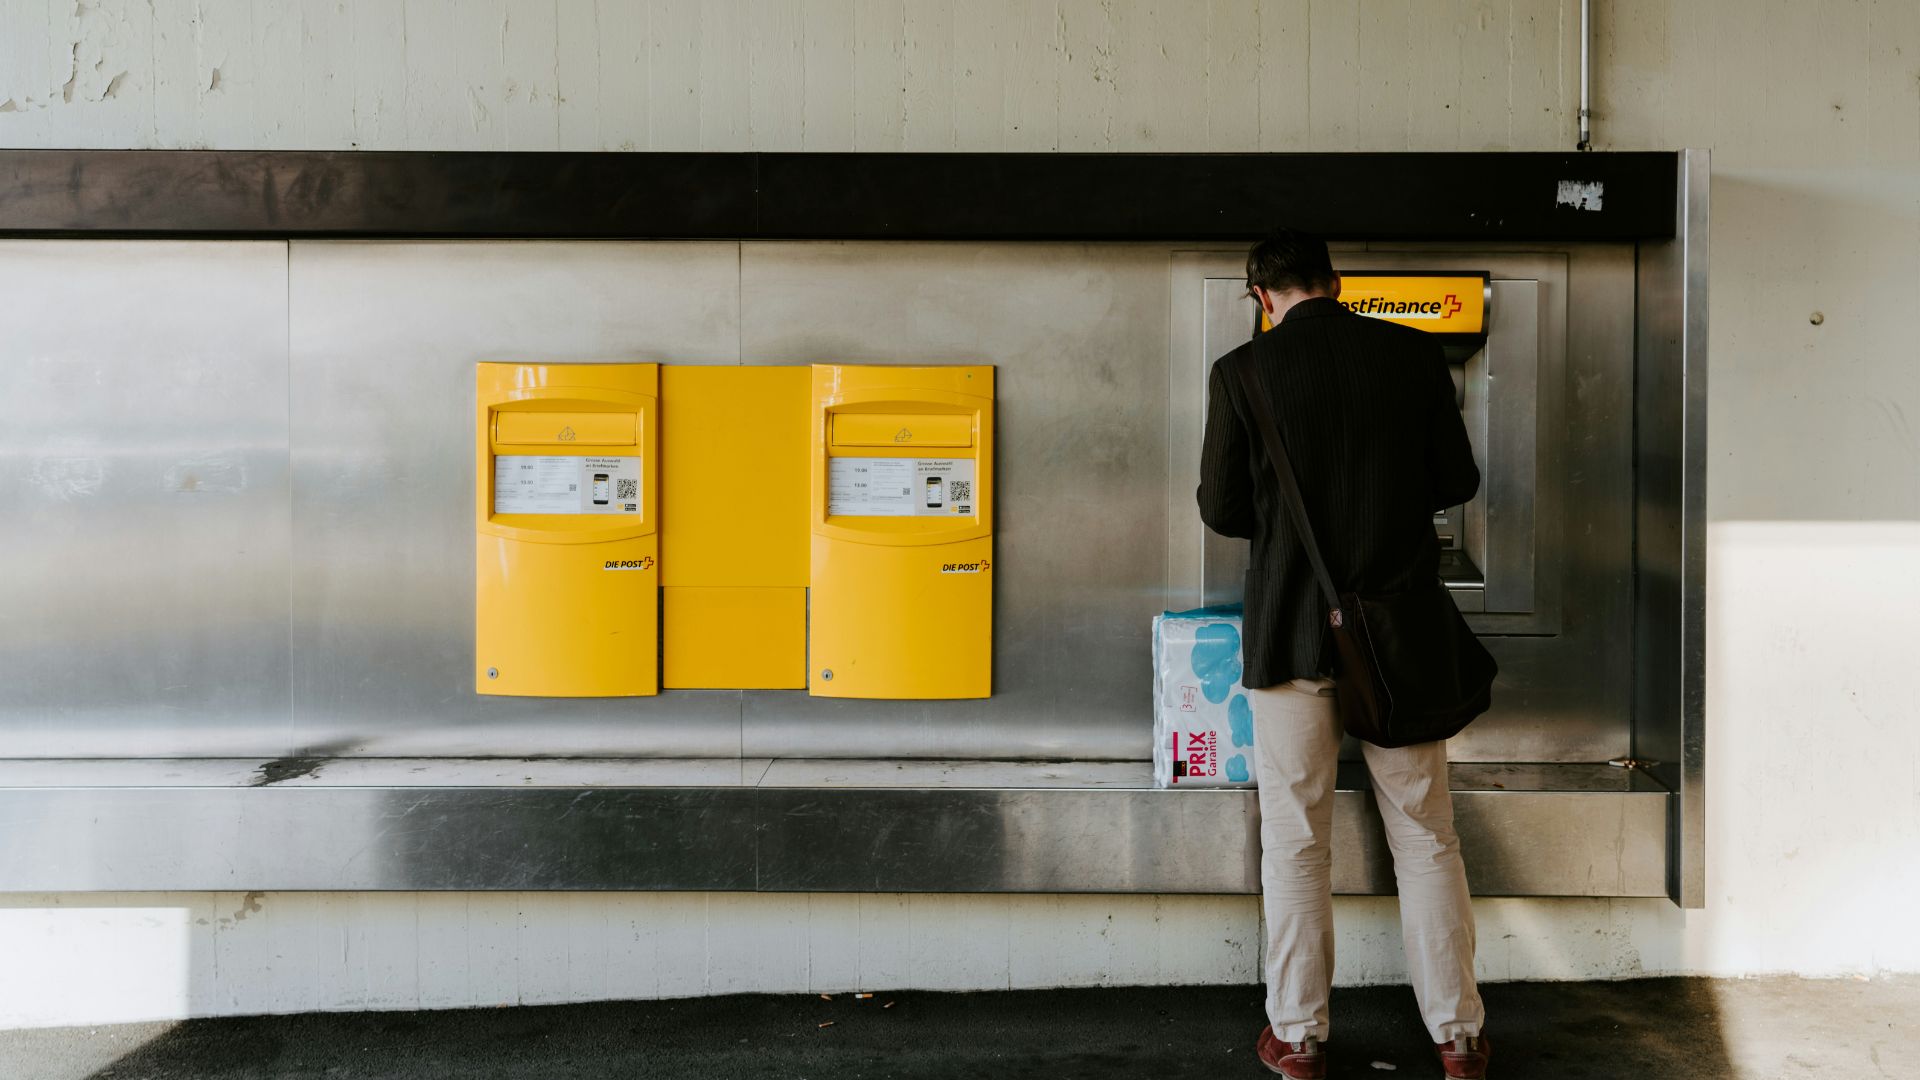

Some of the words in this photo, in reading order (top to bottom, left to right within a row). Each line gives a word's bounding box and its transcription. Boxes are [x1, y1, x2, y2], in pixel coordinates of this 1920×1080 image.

[1339, 297, 1441, 314] ostFinance
[605, 560, 619, 568] DIE
[620, 560, 644, 568] POST
[942, 563, 957, 571] DIE
[957, 563, 980, 571] POST
[1208, 731, 1216, 776] Garantie
